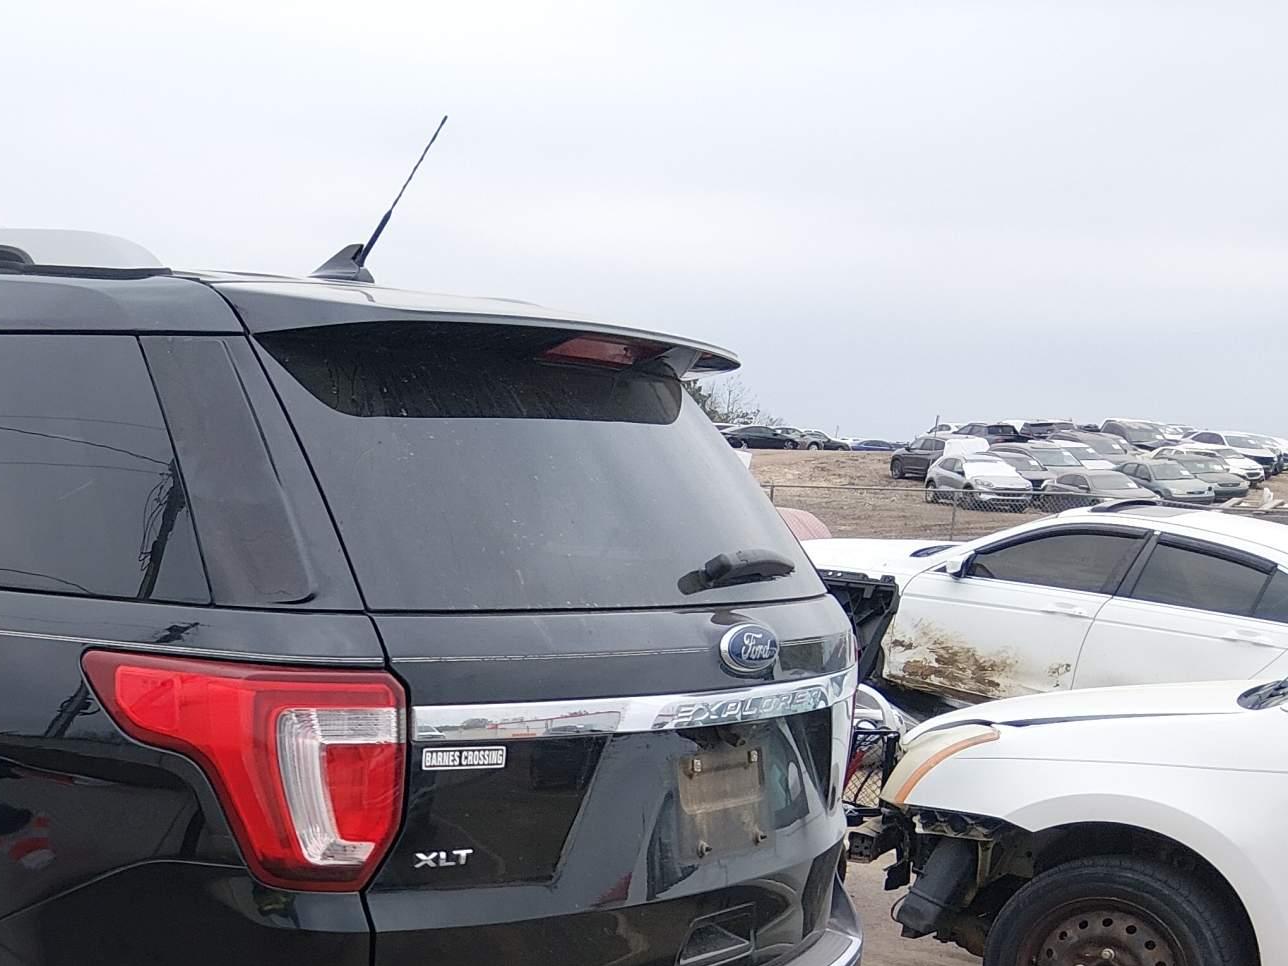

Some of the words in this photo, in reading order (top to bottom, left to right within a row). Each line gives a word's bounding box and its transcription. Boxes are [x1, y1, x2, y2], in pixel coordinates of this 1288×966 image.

[741, 632, 778, 660] Ford
[675, 688, 823, 721] EXPLORER
[425, 751, 460, 766] BARNES
[461, 750, 503, 766] CROSSING
[414, 849, 473, 868] XLT
